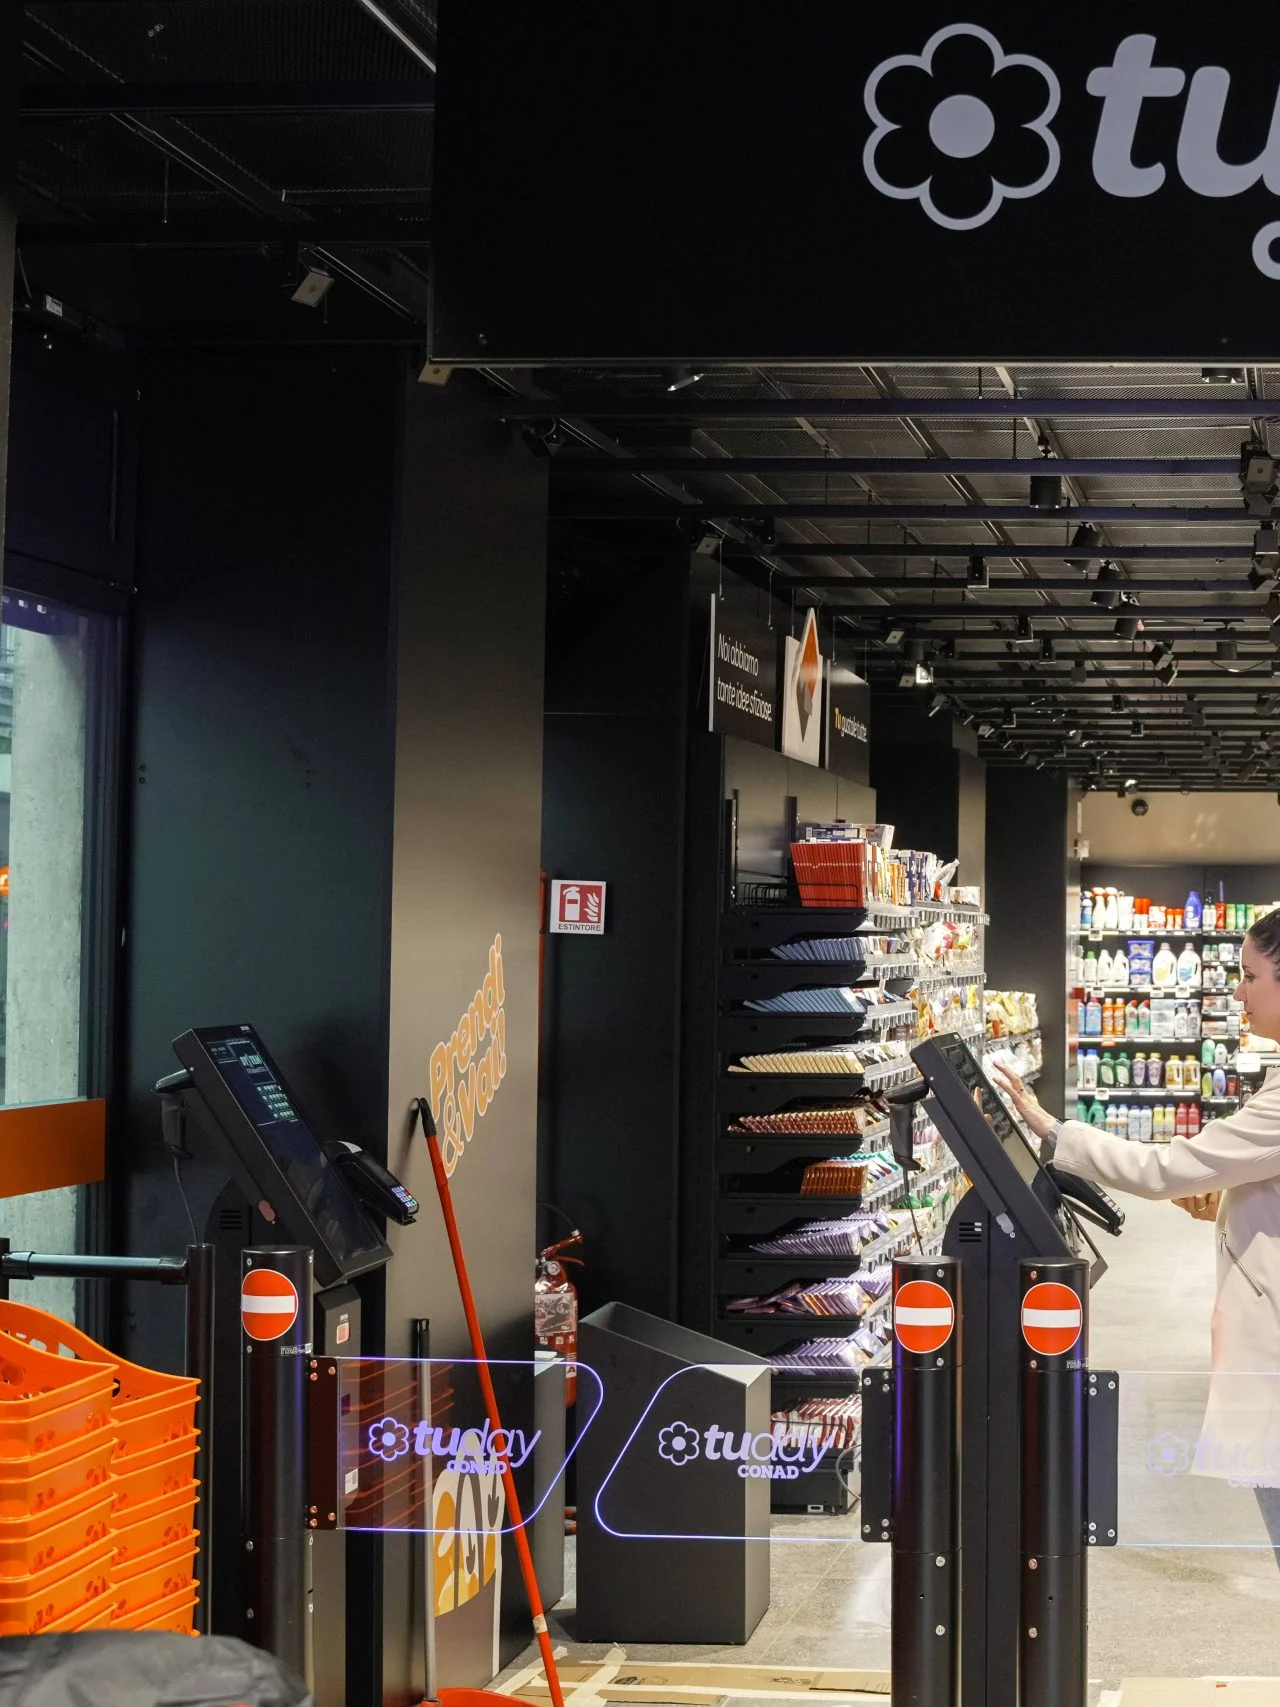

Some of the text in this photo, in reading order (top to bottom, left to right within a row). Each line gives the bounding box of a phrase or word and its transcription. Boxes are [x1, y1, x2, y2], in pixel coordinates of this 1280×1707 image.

[717, 633, 759, 676] Noi abbiamo
[717, 677, 735, 710] tante
[735, 682, 750, 713] idee
[557, 923, 601, 931] ESTINTORE
[430, 933, 505, 1121] Prendi
[413, 1418, 542, 1468] tuday
[704, 1422, 835, 1473] tuday
[737, 1464, 800, 1479] CONAD
